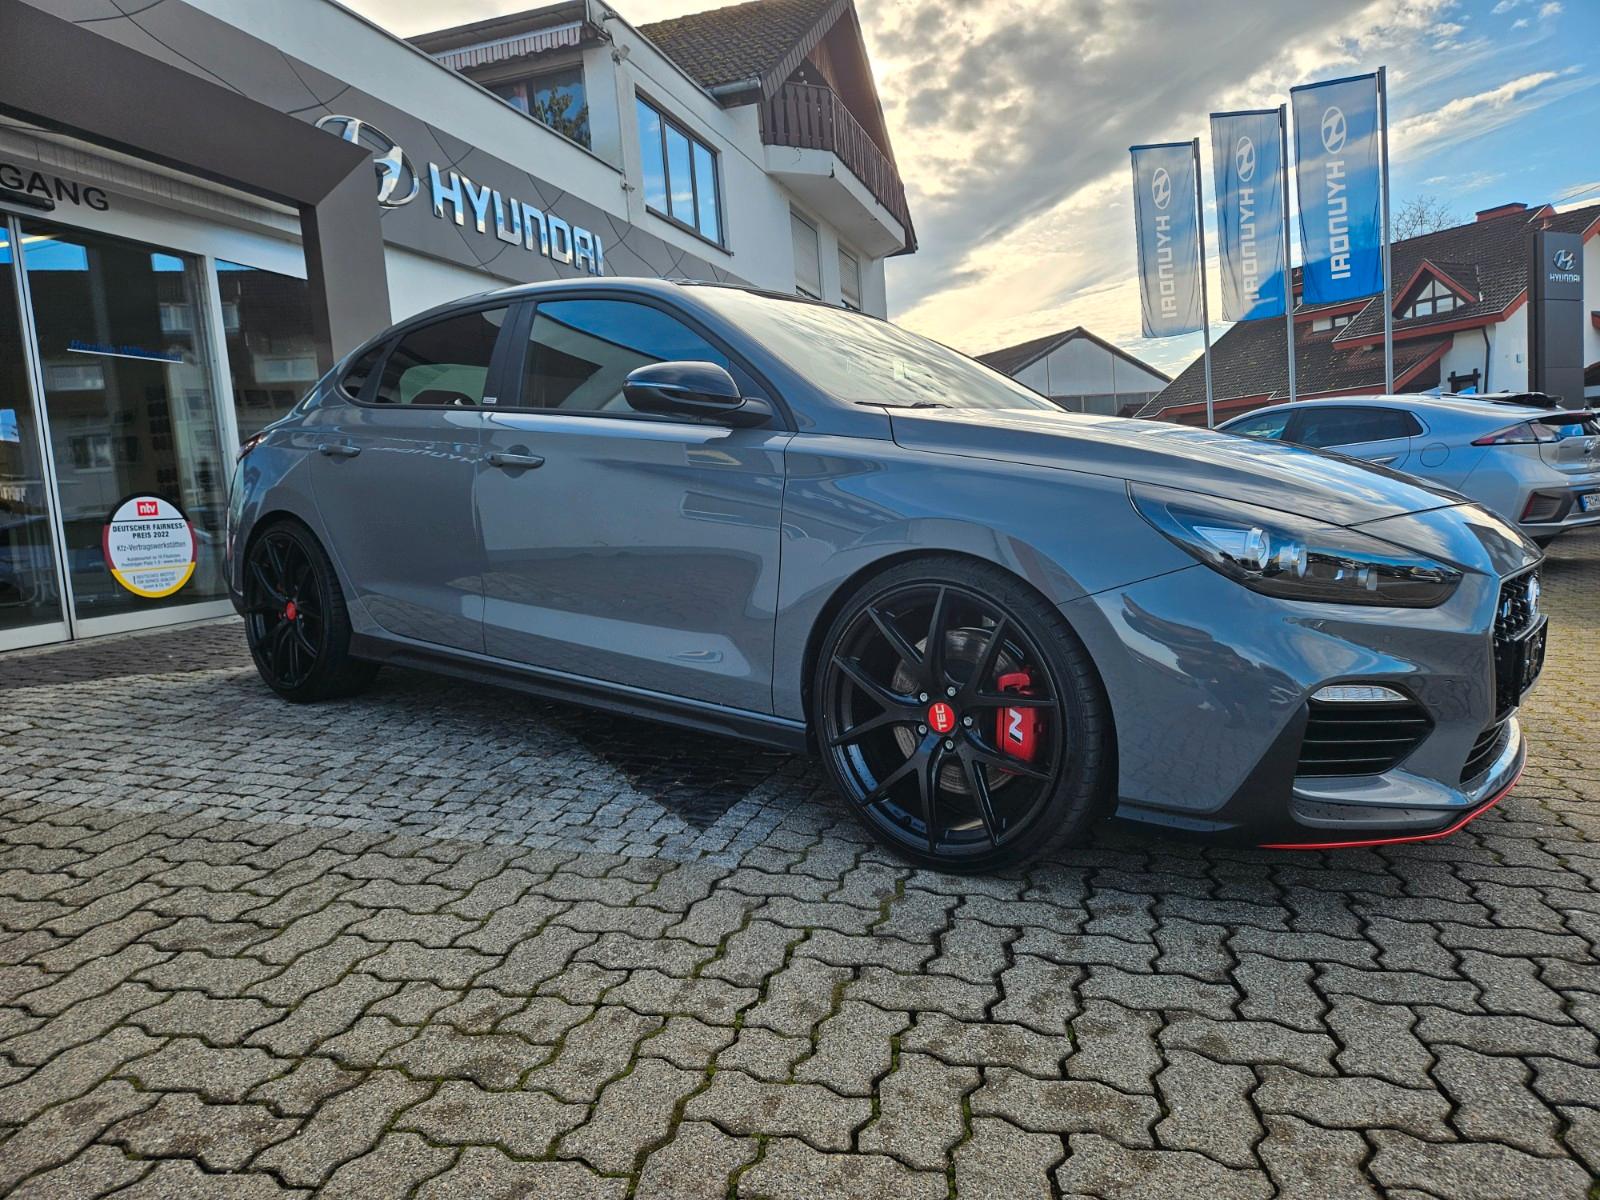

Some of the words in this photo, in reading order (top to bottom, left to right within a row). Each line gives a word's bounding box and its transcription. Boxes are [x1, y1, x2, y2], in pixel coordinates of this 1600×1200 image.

[0, 163, 109, 211] GANG
[428, 161, 604, 277] HYUNDAI
[1549, 273, 1580, 282] HYUNDAI
[140, 502, 155, 514] ntv
[112, 524, 152, 533] DEUTSCHER
[153, 522, 185, 531] FAIRNESS-
[132, 531, 152, 539] PREIS
[935, 704, 948, 730] TEC
